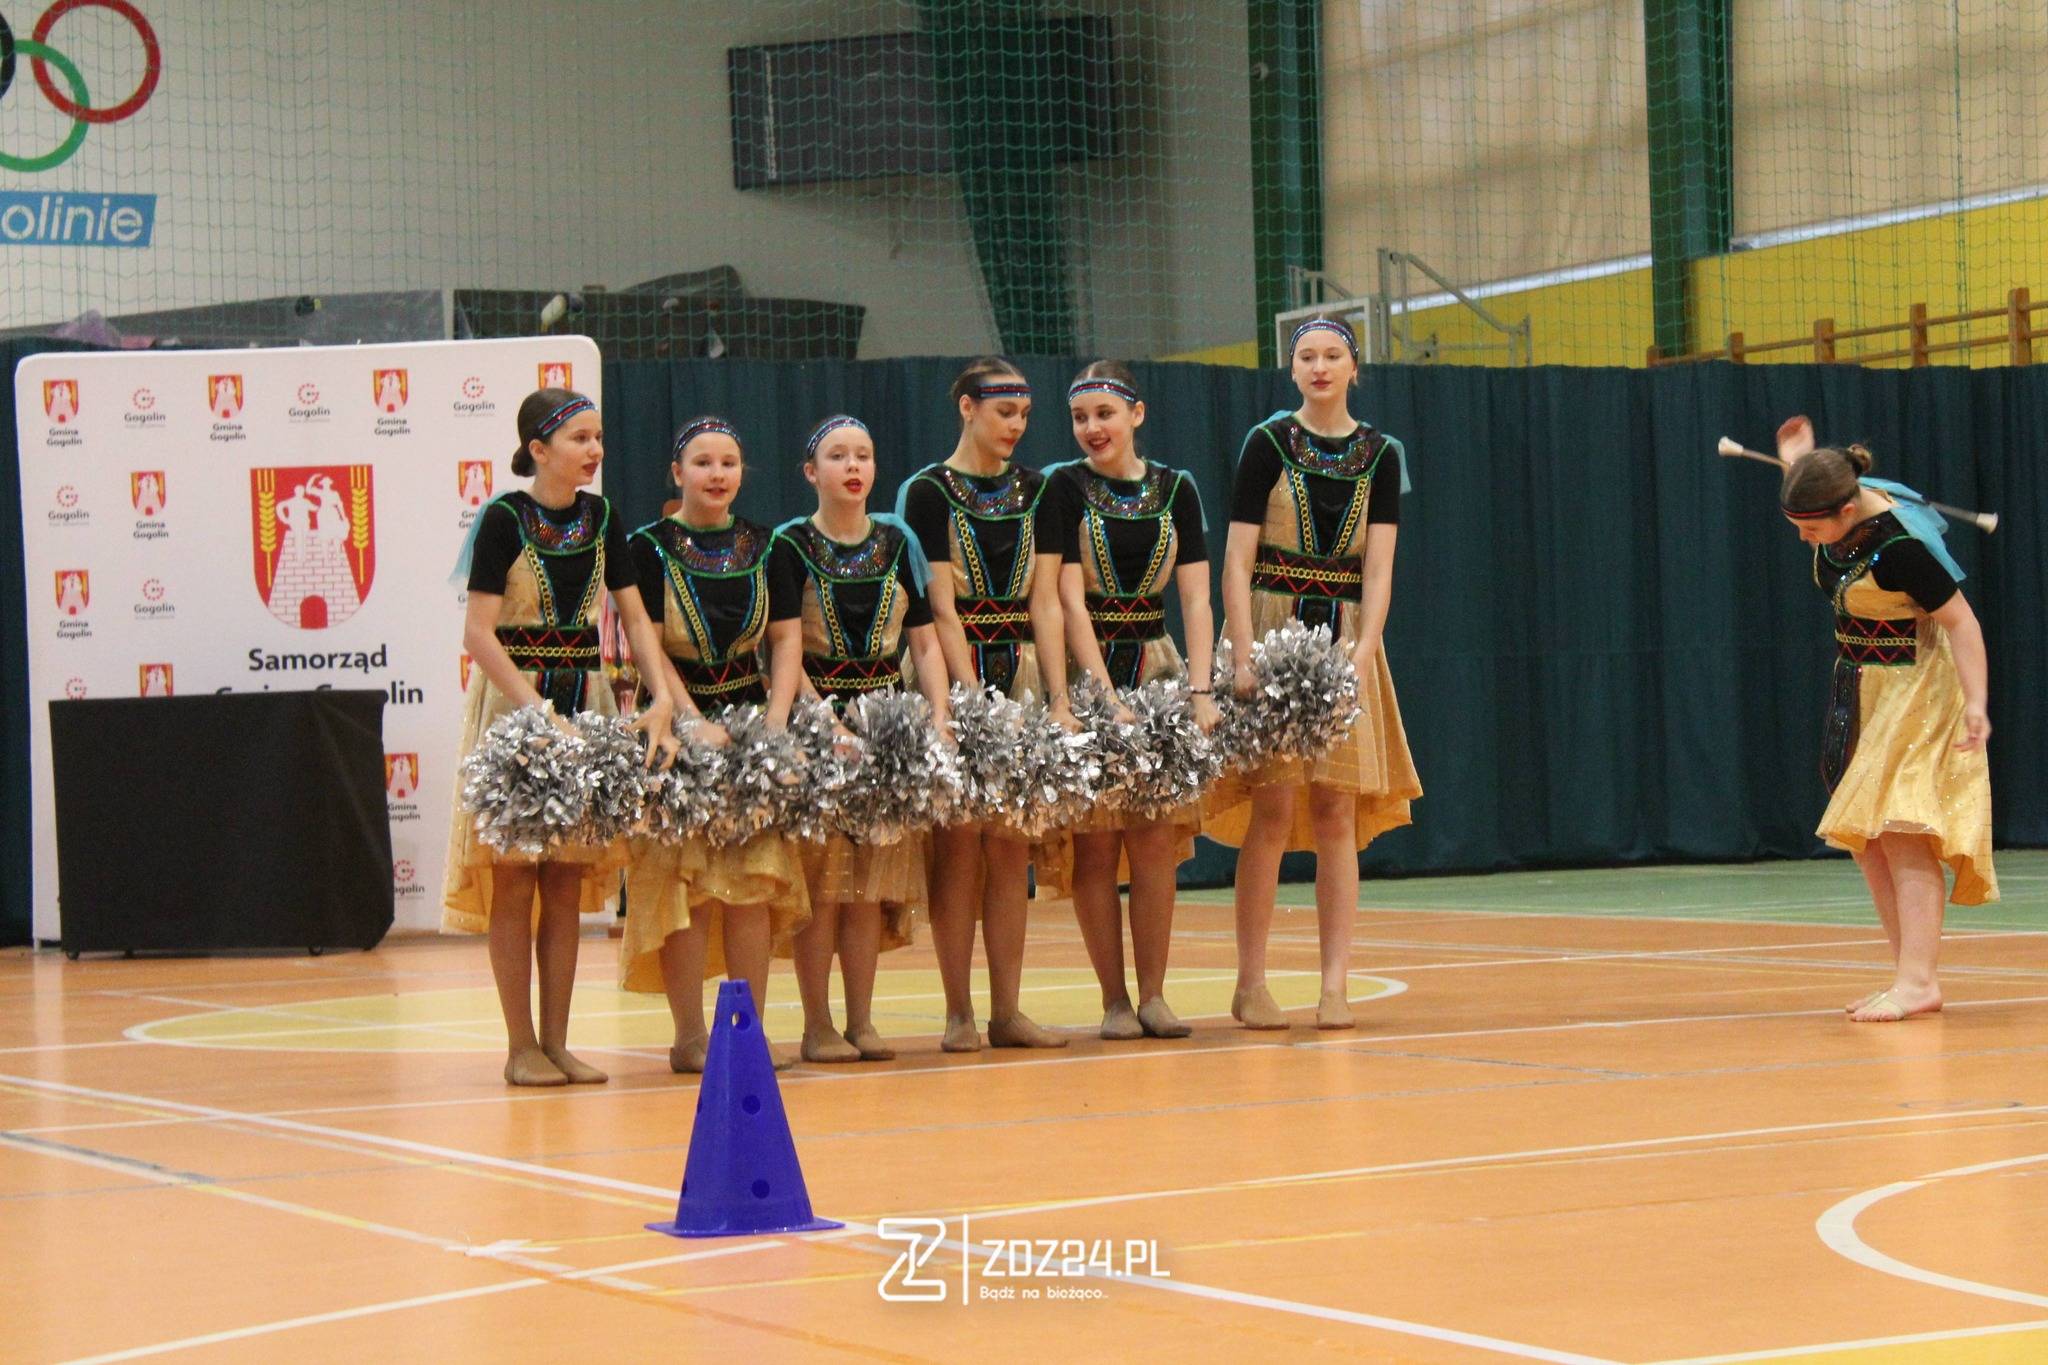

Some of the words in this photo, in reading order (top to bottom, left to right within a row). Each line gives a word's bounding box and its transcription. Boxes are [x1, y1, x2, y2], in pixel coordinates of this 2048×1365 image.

[2, 196, 143, 242] olinie
[453, 400, 495, 412] Gogolin
[124, 412, 166, 423] Gogolin
[289, 407, 330, 418] Gogolin
[212, 422, 242, 432] Gmina
[377, 417, 407, 426] Gmina
[49, 427, 78, 437] Gmina
[210, 431, 246, 442] Gogolin
[374, 426, 410, 436] Gogolin
[47, 436, 82, 447] Gogolin
[48, 510, 89, 521] Gogolin
[136, 520, 165, 529] Gmina
[133, 529, 168, 539] Gogolin
[134, 603, 175, 614] Gogolin
[59, 619, 88, 629] Gmina
[57, 629, 92, 640] Gogolin
[248, 644, 387, 673] Samorząd
[389, 813, 421, 822] ogolin
